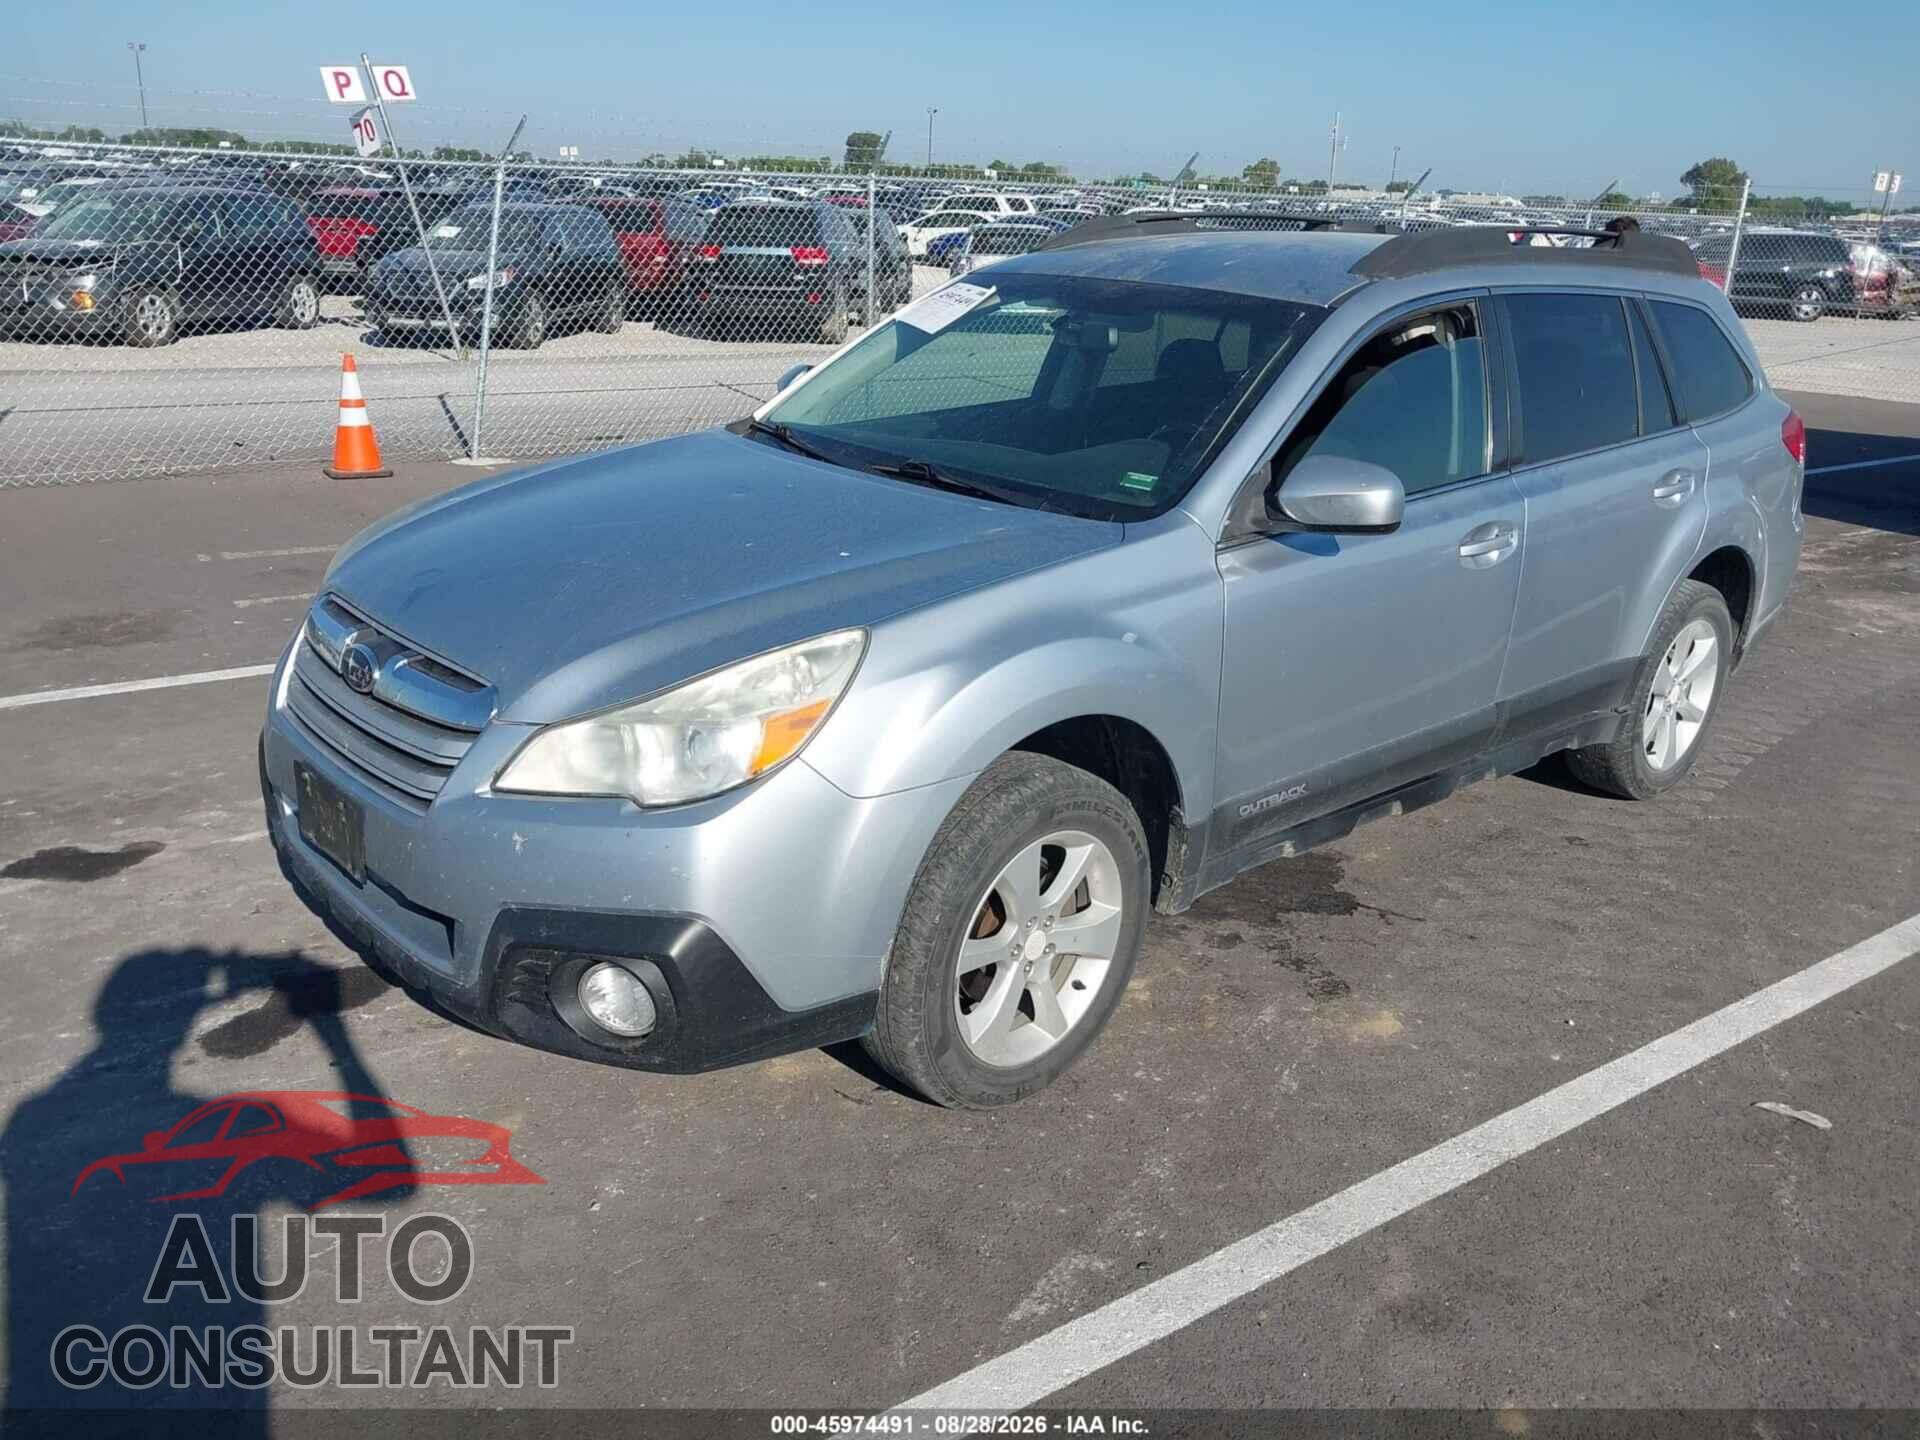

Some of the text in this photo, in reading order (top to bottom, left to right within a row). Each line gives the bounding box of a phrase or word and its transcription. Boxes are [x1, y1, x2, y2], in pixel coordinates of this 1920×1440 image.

[332, 71, 352, 99] P
[383, 70, 410, 97] Q
[353, 118, 376, 147] 70
[1239, 783, 1307, 817] OUTBACK
